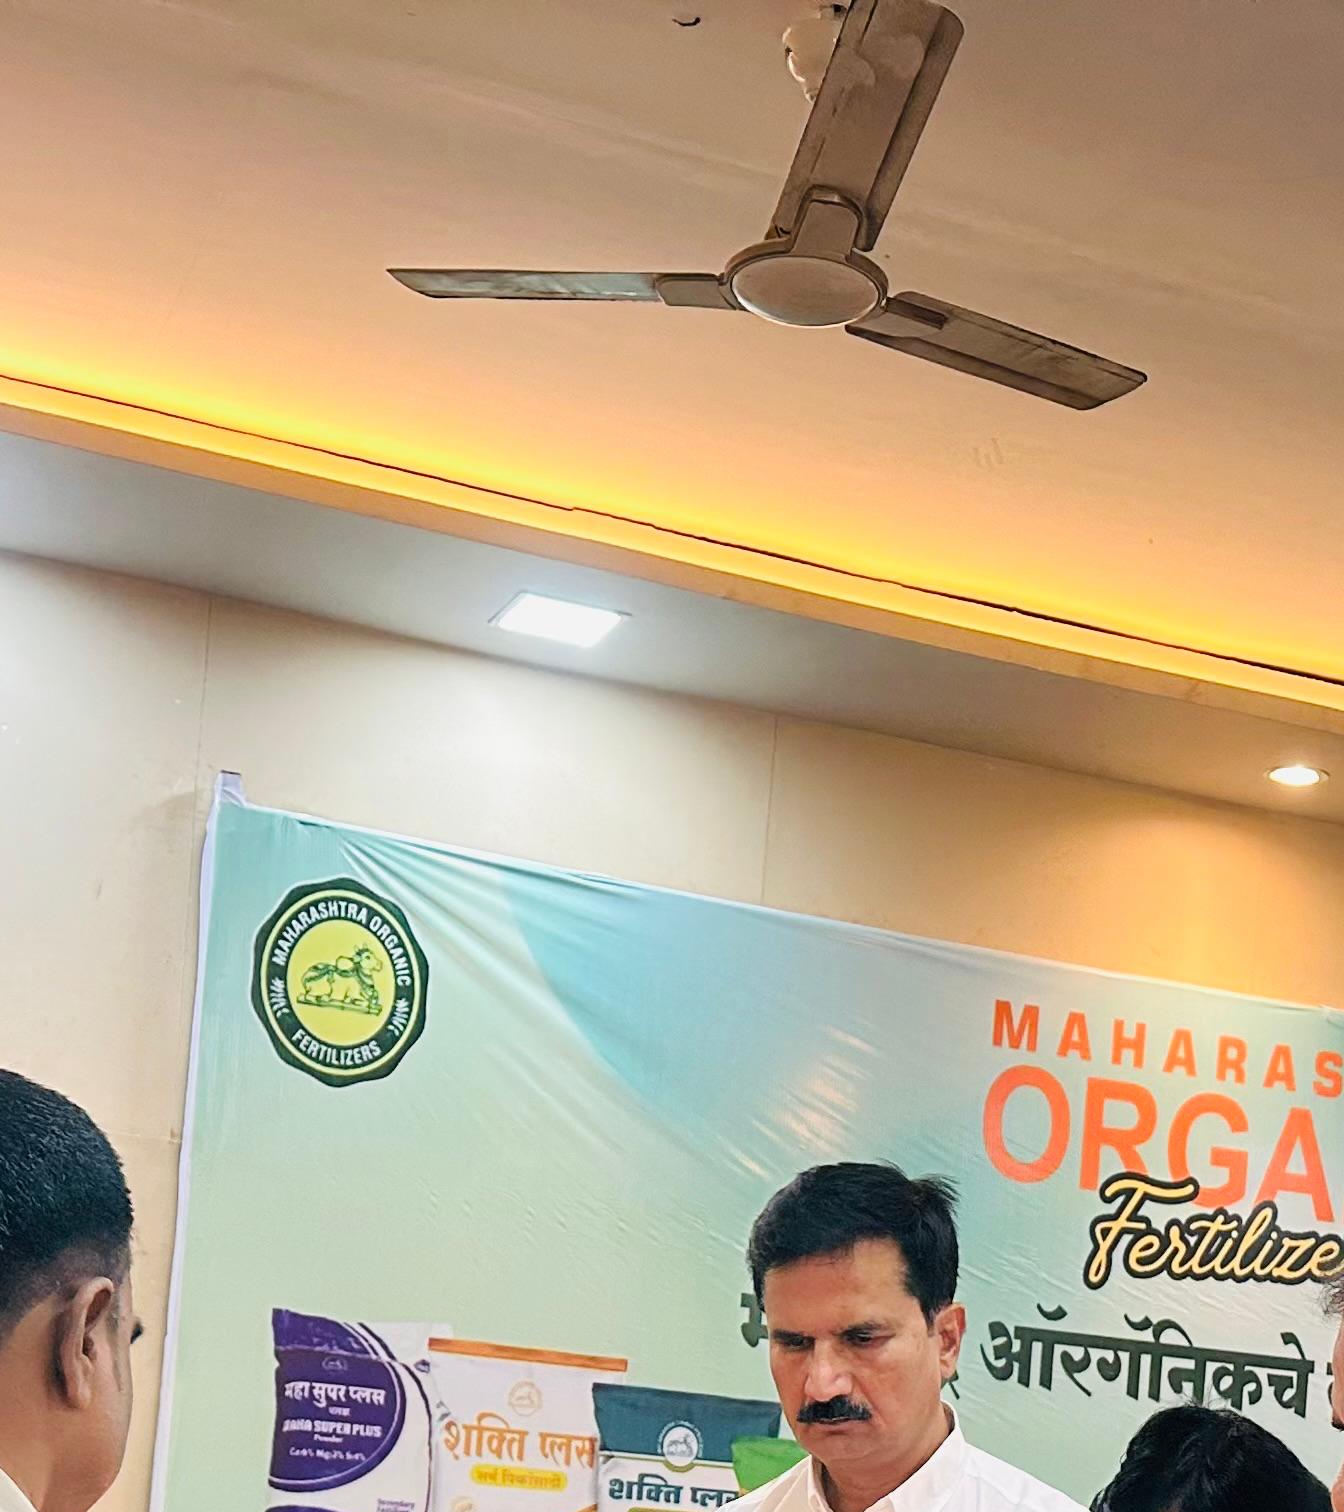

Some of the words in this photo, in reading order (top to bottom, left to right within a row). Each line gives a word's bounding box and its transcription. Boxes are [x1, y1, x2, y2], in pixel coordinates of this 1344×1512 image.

[272, 900, 368, 967] MAHARASHTRA
[368, 915, 413, 988] ORGANIC
[291, 1029, 381, 1066] FERTILIZERS
[980, 1302, 1315, 1419] ऑरगॅनिकचे
[444, 1411, 529, 1462] शक्ति
[538, 1432, 598, 1469] प्लस
[608, 1473, 684, 1504] शक्ति
